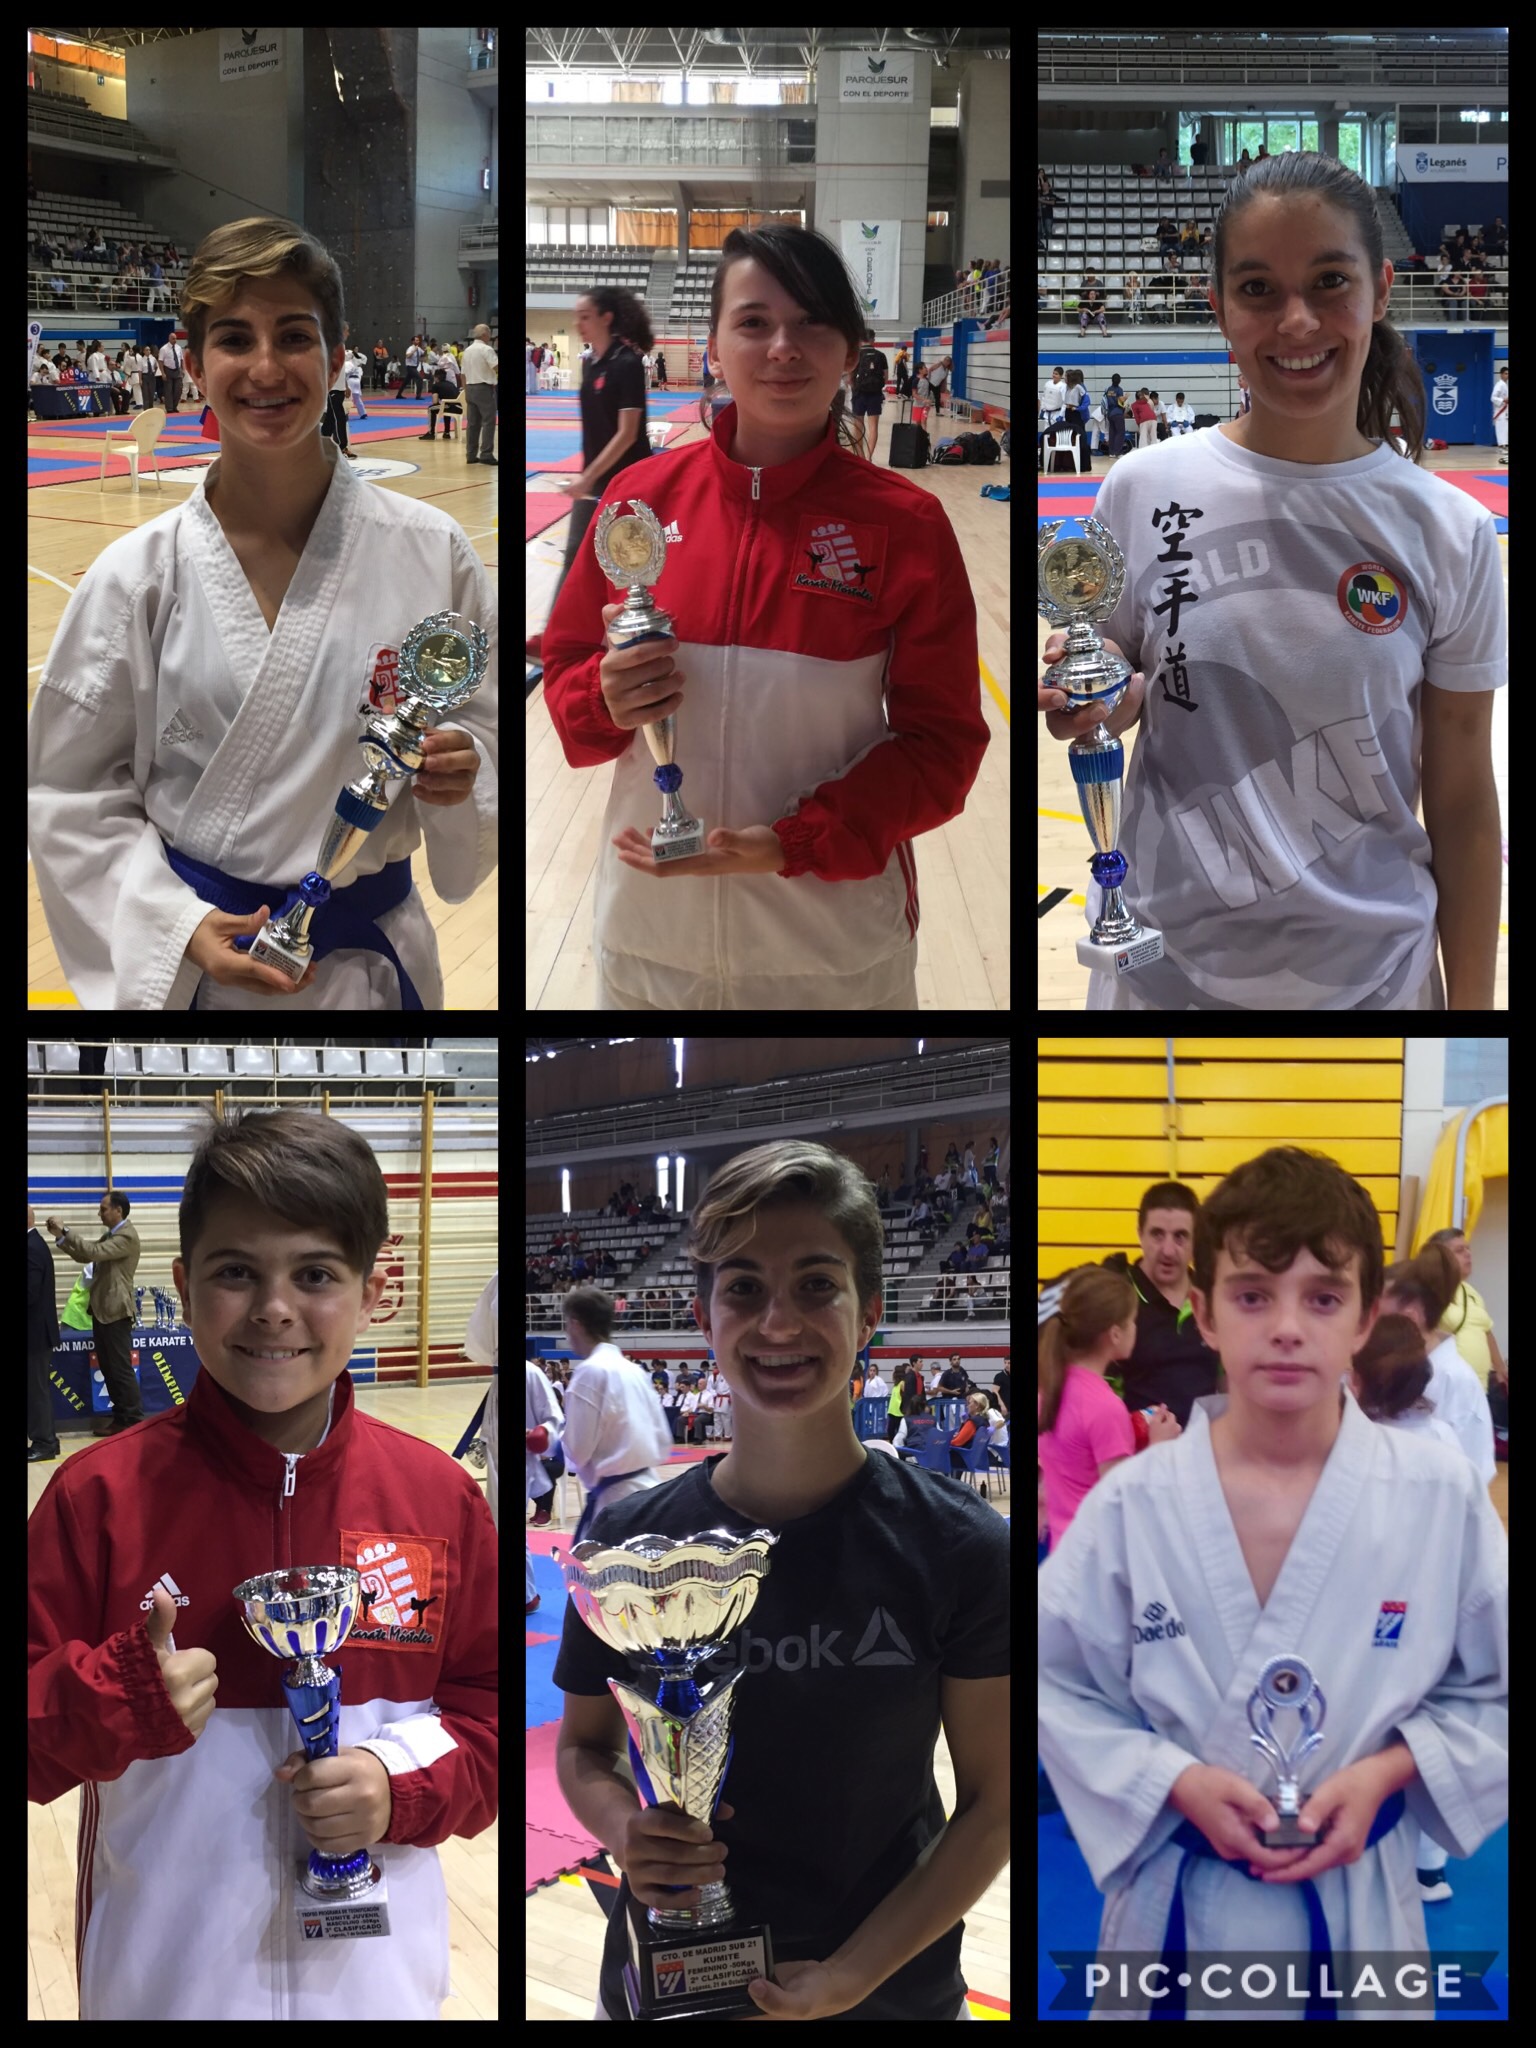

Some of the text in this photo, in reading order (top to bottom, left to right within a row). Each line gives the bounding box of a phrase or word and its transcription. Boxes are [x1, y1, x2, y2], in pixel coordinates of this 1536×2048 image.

[224, 43, 277, 60] PARQUESUR
[223, 67, 237, 75] CON
[248, 59, 279, 70] DEPORTE
[846, 76, 908, 84] PARQUESUR
[1430, 158, 1467, 168] Leganés
[1496, 157, 1507, 171] P
[665, 534, 683, 543] das
[1148, 538, 1271, 612] ORLD
[1360, 563, 1386, 573] WORLD
[796, 573, 829, 589] Karate
[1357, 588, 1391, 606] WKF
[1152, 501, 1203, 712] 空手道
[1344, 610, 1366, 630] KARATE
[1176, 713, 1391, 911] WKF
[73, 1341, 96, 1351] MAD
[132, 1337, 146, 1348] DE
[149, 1336, 186, 1347] KARATE
[152, 1351, 185, 1406] OLÍMPICO
[49, 1370, 85, 1411] ARATE
[140, 1595, 190, 1611] aas
[703, 1624, 845, 1675] ebok
[333, 1924, 382, 1932] CLASIFICADO
[661, 1953, 680, 1962] CTO.
[696, 1945, 727, 1955] MADRID
[729, 1942, 745, 1950] SUB
[703, 1953, 740, 1964] KUMITE
[688, 1964, 728, 1975] FEMENINO
[701, 1967, 759, 1982] CLASIFICADA
